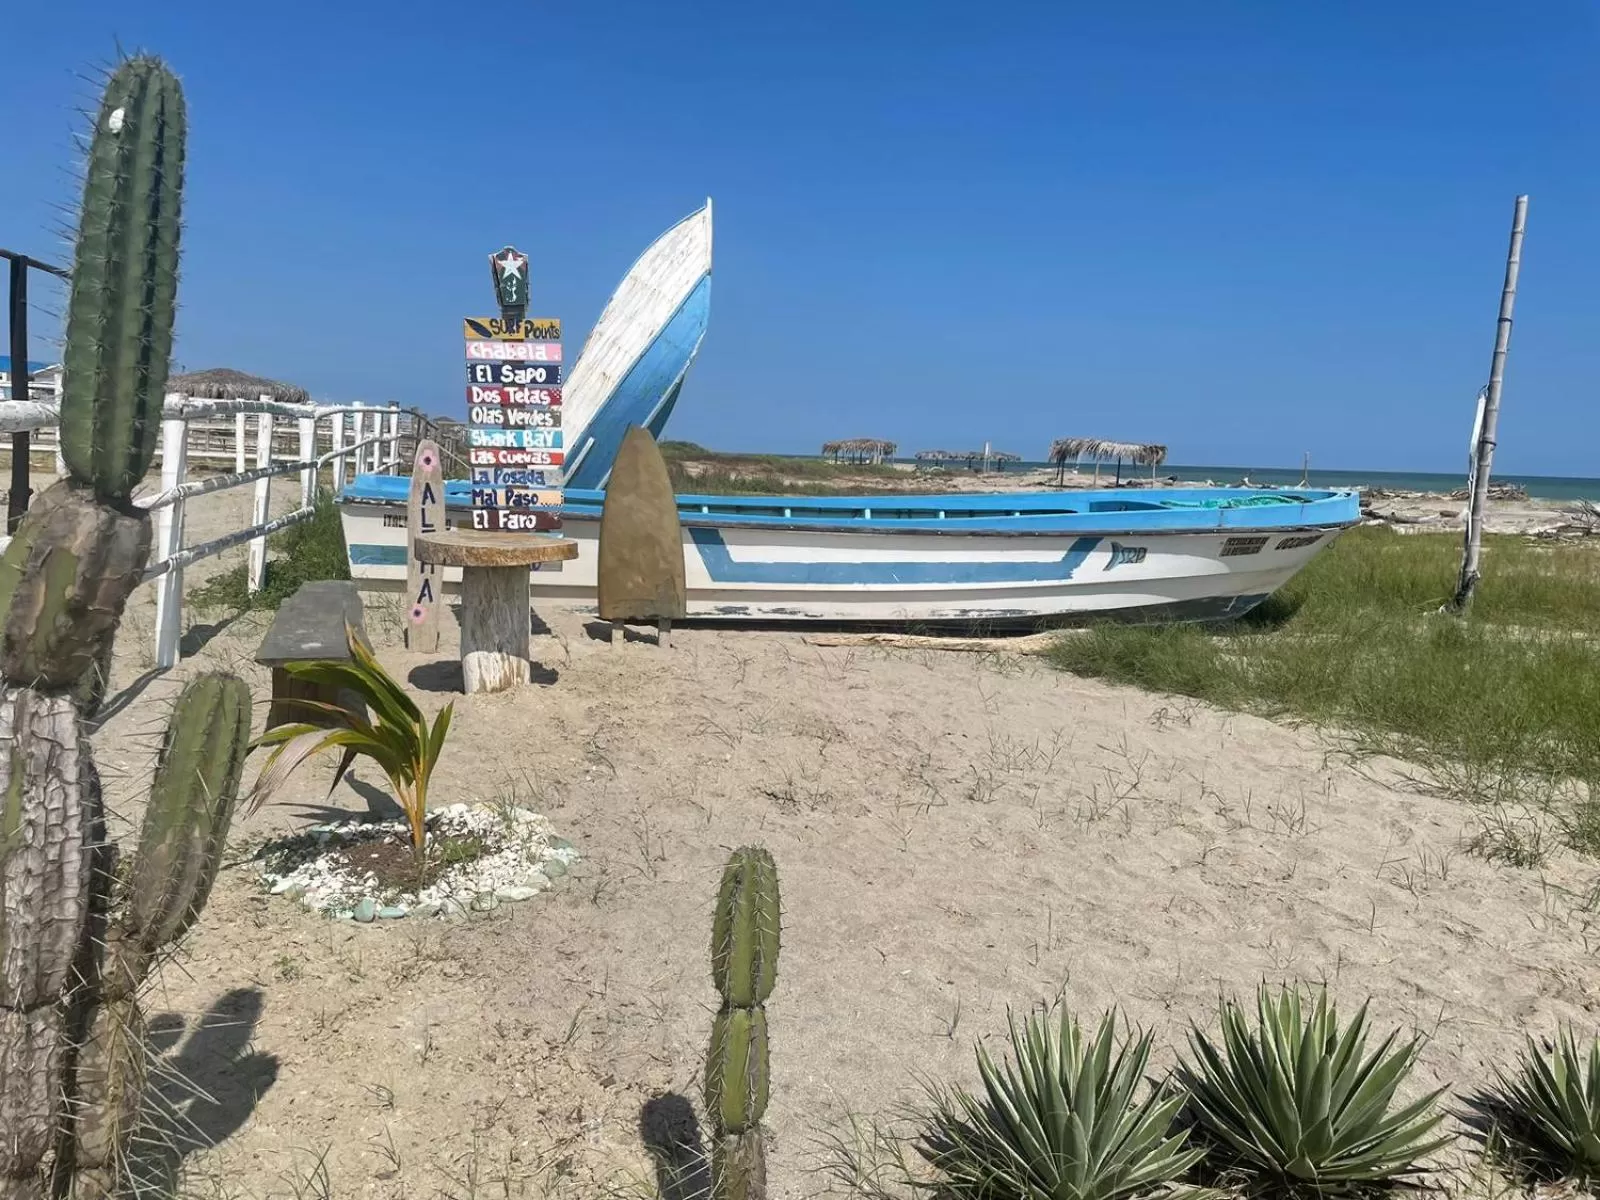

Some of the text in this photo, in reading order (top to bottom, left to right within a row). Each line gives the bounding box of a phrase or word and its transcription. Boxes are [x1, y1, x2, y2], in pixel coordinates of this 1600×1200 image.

[525, 319, 560, 339] Points
[469, 343, 547, 360] Chabela
[476, 364, 492, 382] El
[472, 386, 501, 403] Dos
[472, 406, 554, 426] Olas Verdes
[470, 448, 551, 464] Las Cuevas
[472, 468, 545, 485] La Posada
[472, 487, 539, 507] Mal Paso
[473, 510, 489, 528] El
[499, 510, 536, 528] Faro
